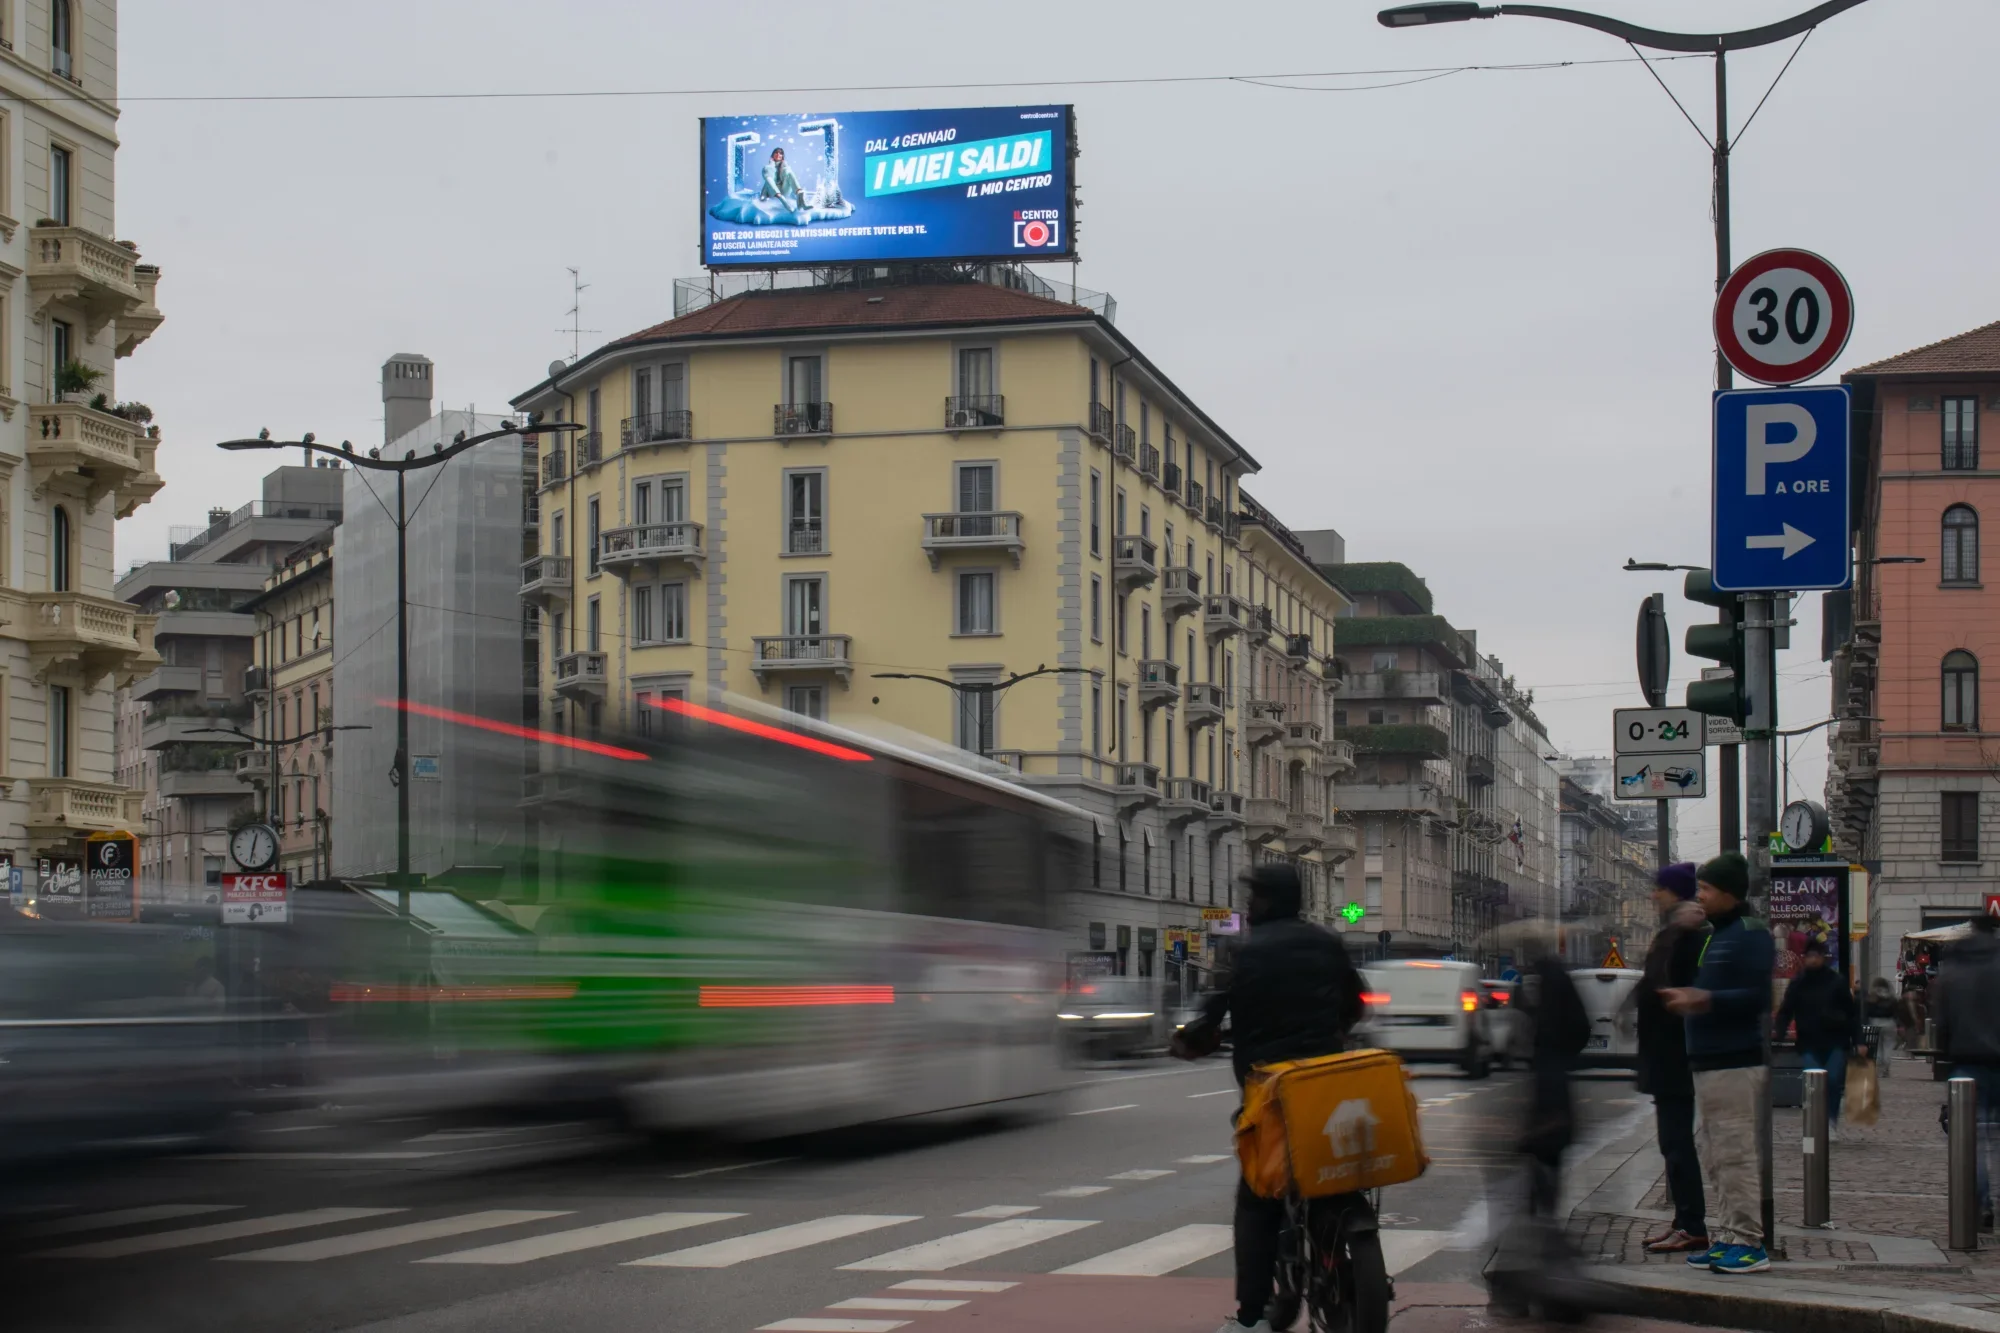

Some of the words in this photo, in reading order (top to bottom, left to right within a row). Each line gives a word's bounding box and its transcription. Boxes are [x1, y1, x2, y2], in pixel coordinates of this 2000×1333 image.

[865, 139, 889, 153] DAL
[891, 137, 900, 149] 4
[901, 128, 957, 147] GENNAIO
[873, 161, 887, 190] I
[889, 151, 955, 187] MIEI
[957, 138, 1043, 177] SALDI
[966, 185, 978, 198] IL
[980, 180, 1003, 196] MIO
[1004, 174, 1053, 192] CENTRO
[712, 231, 736, 241] OLTRE
[737, 231, 753, 240] 200
[754, 229, 783, 239] NEGOZI
[785, 229, 790, 238] E
[790, 227, 837, 238] TANTISSIME
[838, 227, 871, 236] OFFERTE
[873, 226, 897, 235] TUTTE
[898, 225, 914, 234] PER
[915, 225, 927, 234] TE.
[712, 242, 722, 250] A8
[723, 241, 746, 250] USCITA
[747, 240, 799, 249] LAINATE/ARESE
[1747, 286, 1820, 346] 30
[1745, 402, 1818, 496] P
[1774, 481, 1788, 494] A
[1792, 479, 1831, 493] ORE
[12, 871, 21, 892] P
[91, 867, 131, 880] FAVERO
[233, 875, 278, 891] KFC
[47, 895, 75, 903] CAFFETTERIA
[264, 905, 273, 913] 50
[1770, 904, 1822, 912] ALLEGORIA
